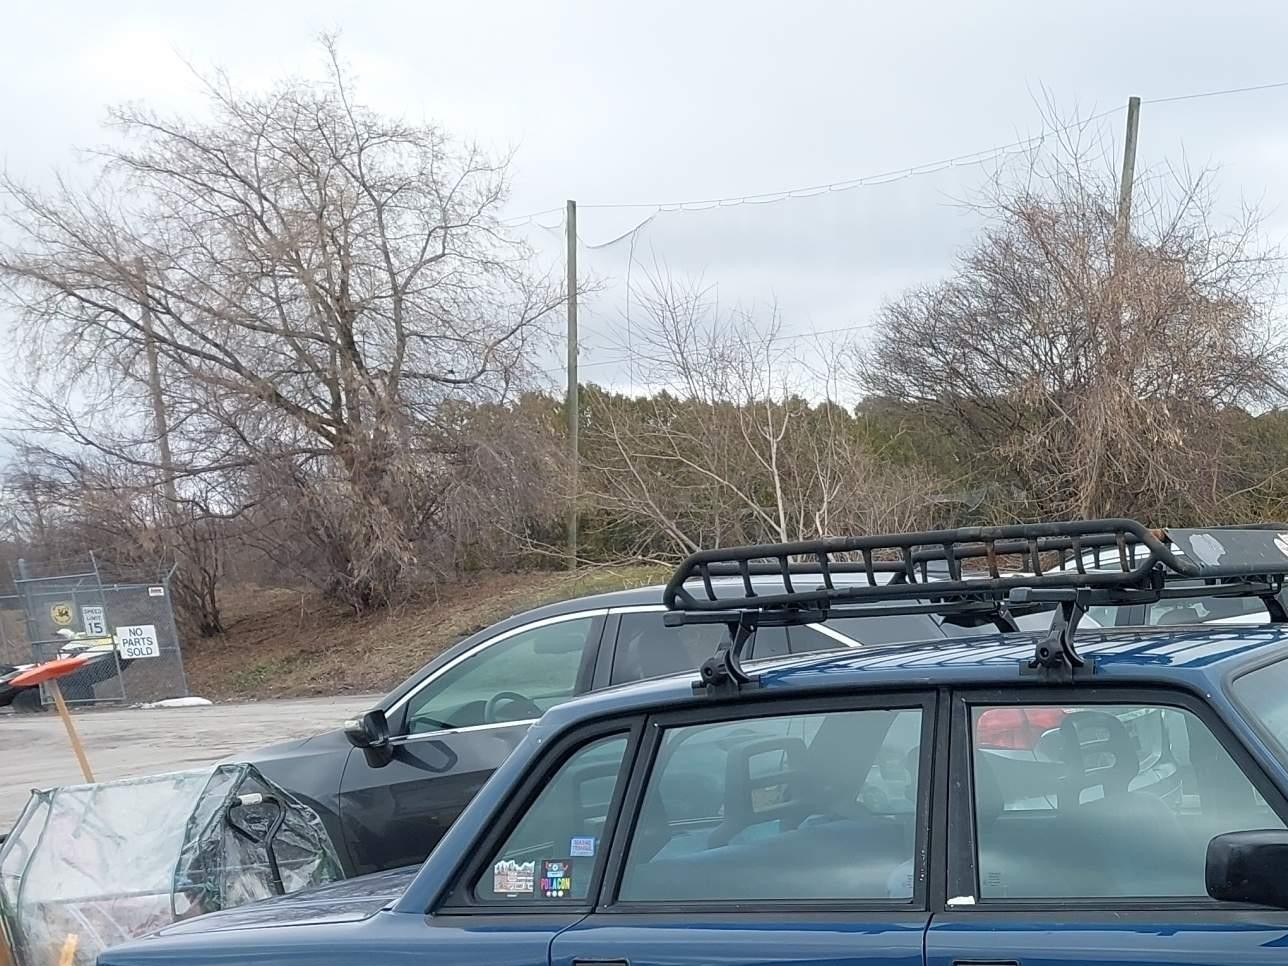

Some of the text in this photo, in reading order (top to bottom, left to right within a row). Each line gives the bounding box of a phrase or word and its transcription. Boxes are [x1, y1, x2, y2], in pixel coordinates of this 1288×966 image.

[88, 622, 103, 634] 15
[128, 627, 143, 637] NO
[122, 637, 153, 647] PARTS
[127, 647, 153, 657] SOLD
